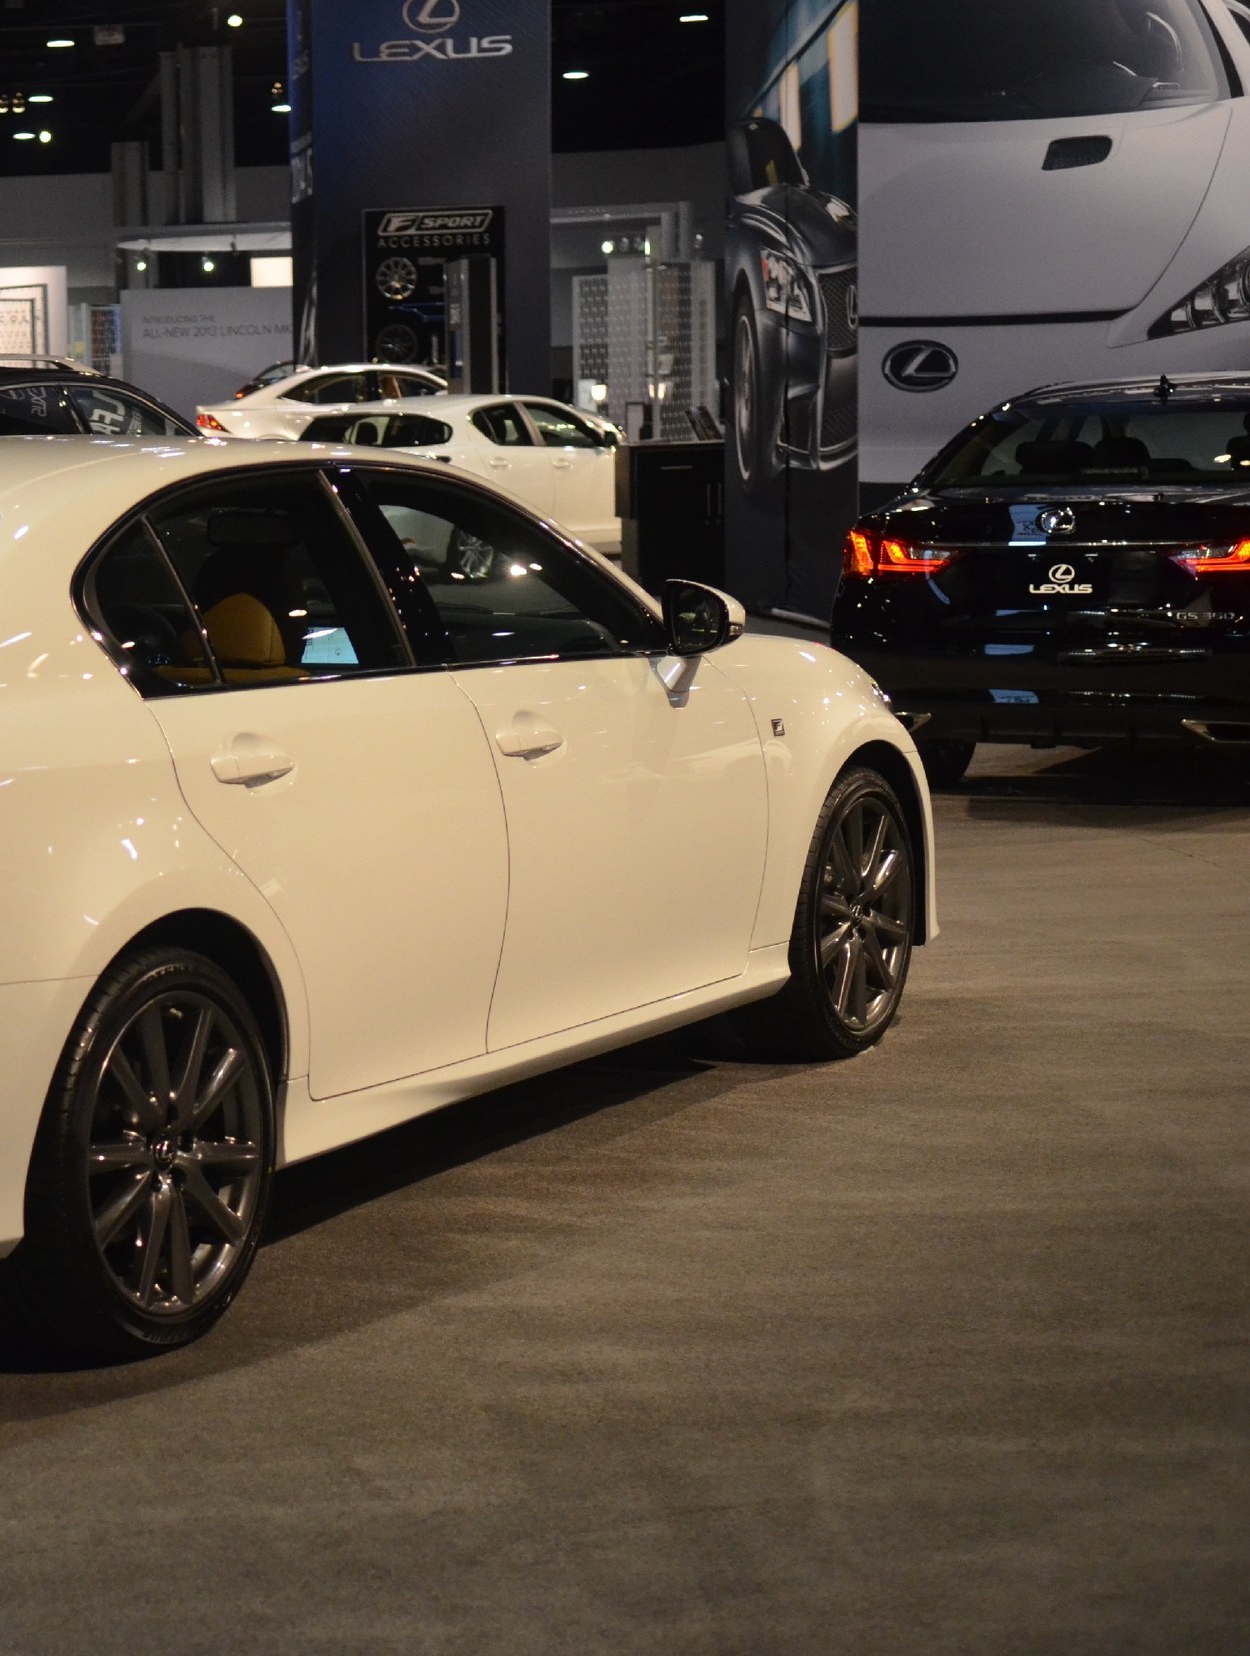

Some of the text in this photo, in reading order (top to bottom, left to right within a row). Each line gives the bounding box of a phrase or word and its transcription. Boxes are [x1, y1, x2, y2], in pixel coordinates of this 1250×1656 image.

[352, 34, 514, 62] LEXUS
[421, 215, 486, 229] SPORT
[378, 233, 491, 249] ACCESSORIES
[143, 326, 191, 338] ALL-NEW
[221, 324, 272, 336] LINCOLN
[274, 323, 293, 334] MK
[1029, 584, 1093, 594] LEXUS
[1176, 611, 1198, 620] GS
